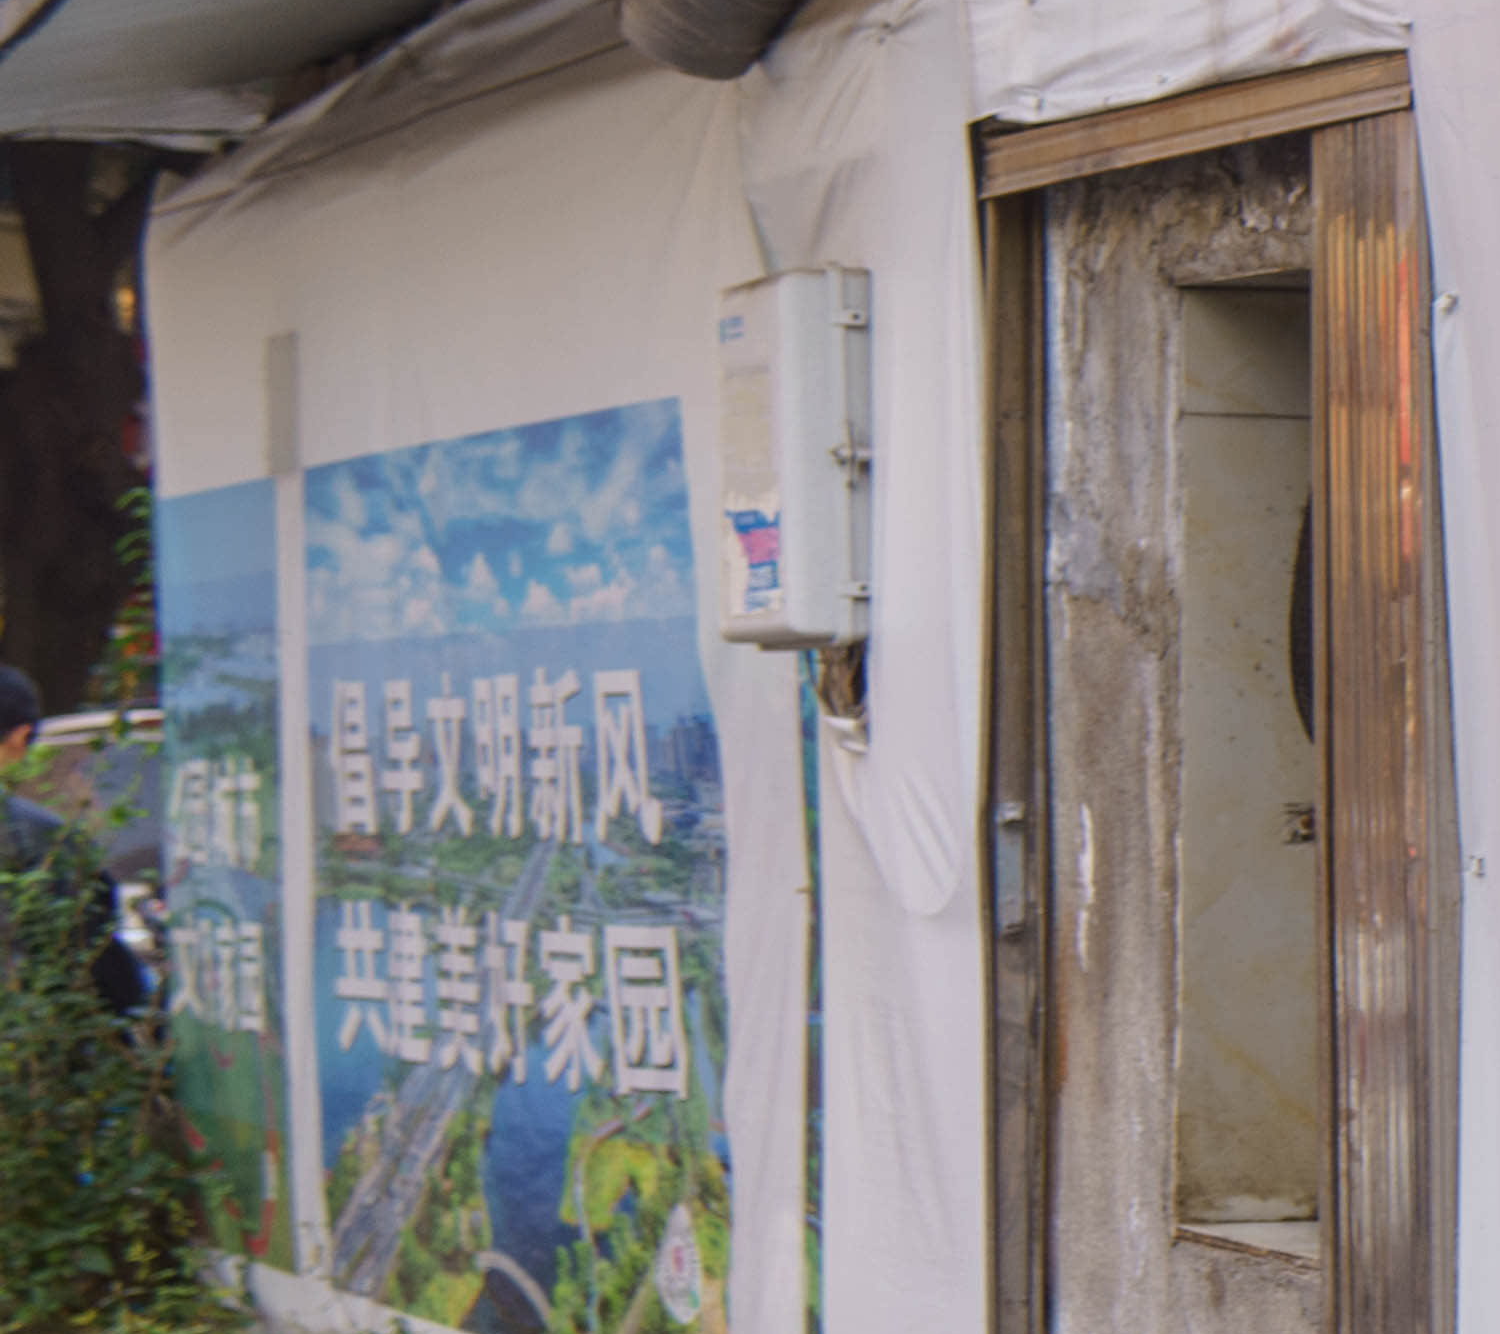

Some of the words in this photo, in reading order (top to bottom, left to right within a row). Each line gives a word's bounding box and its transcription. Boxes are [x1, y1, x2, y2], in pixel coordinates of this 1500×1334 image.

[334, 668, 664, 844] 倡导文明新风
[334, 902, 689, 1099] 共建美好家园
